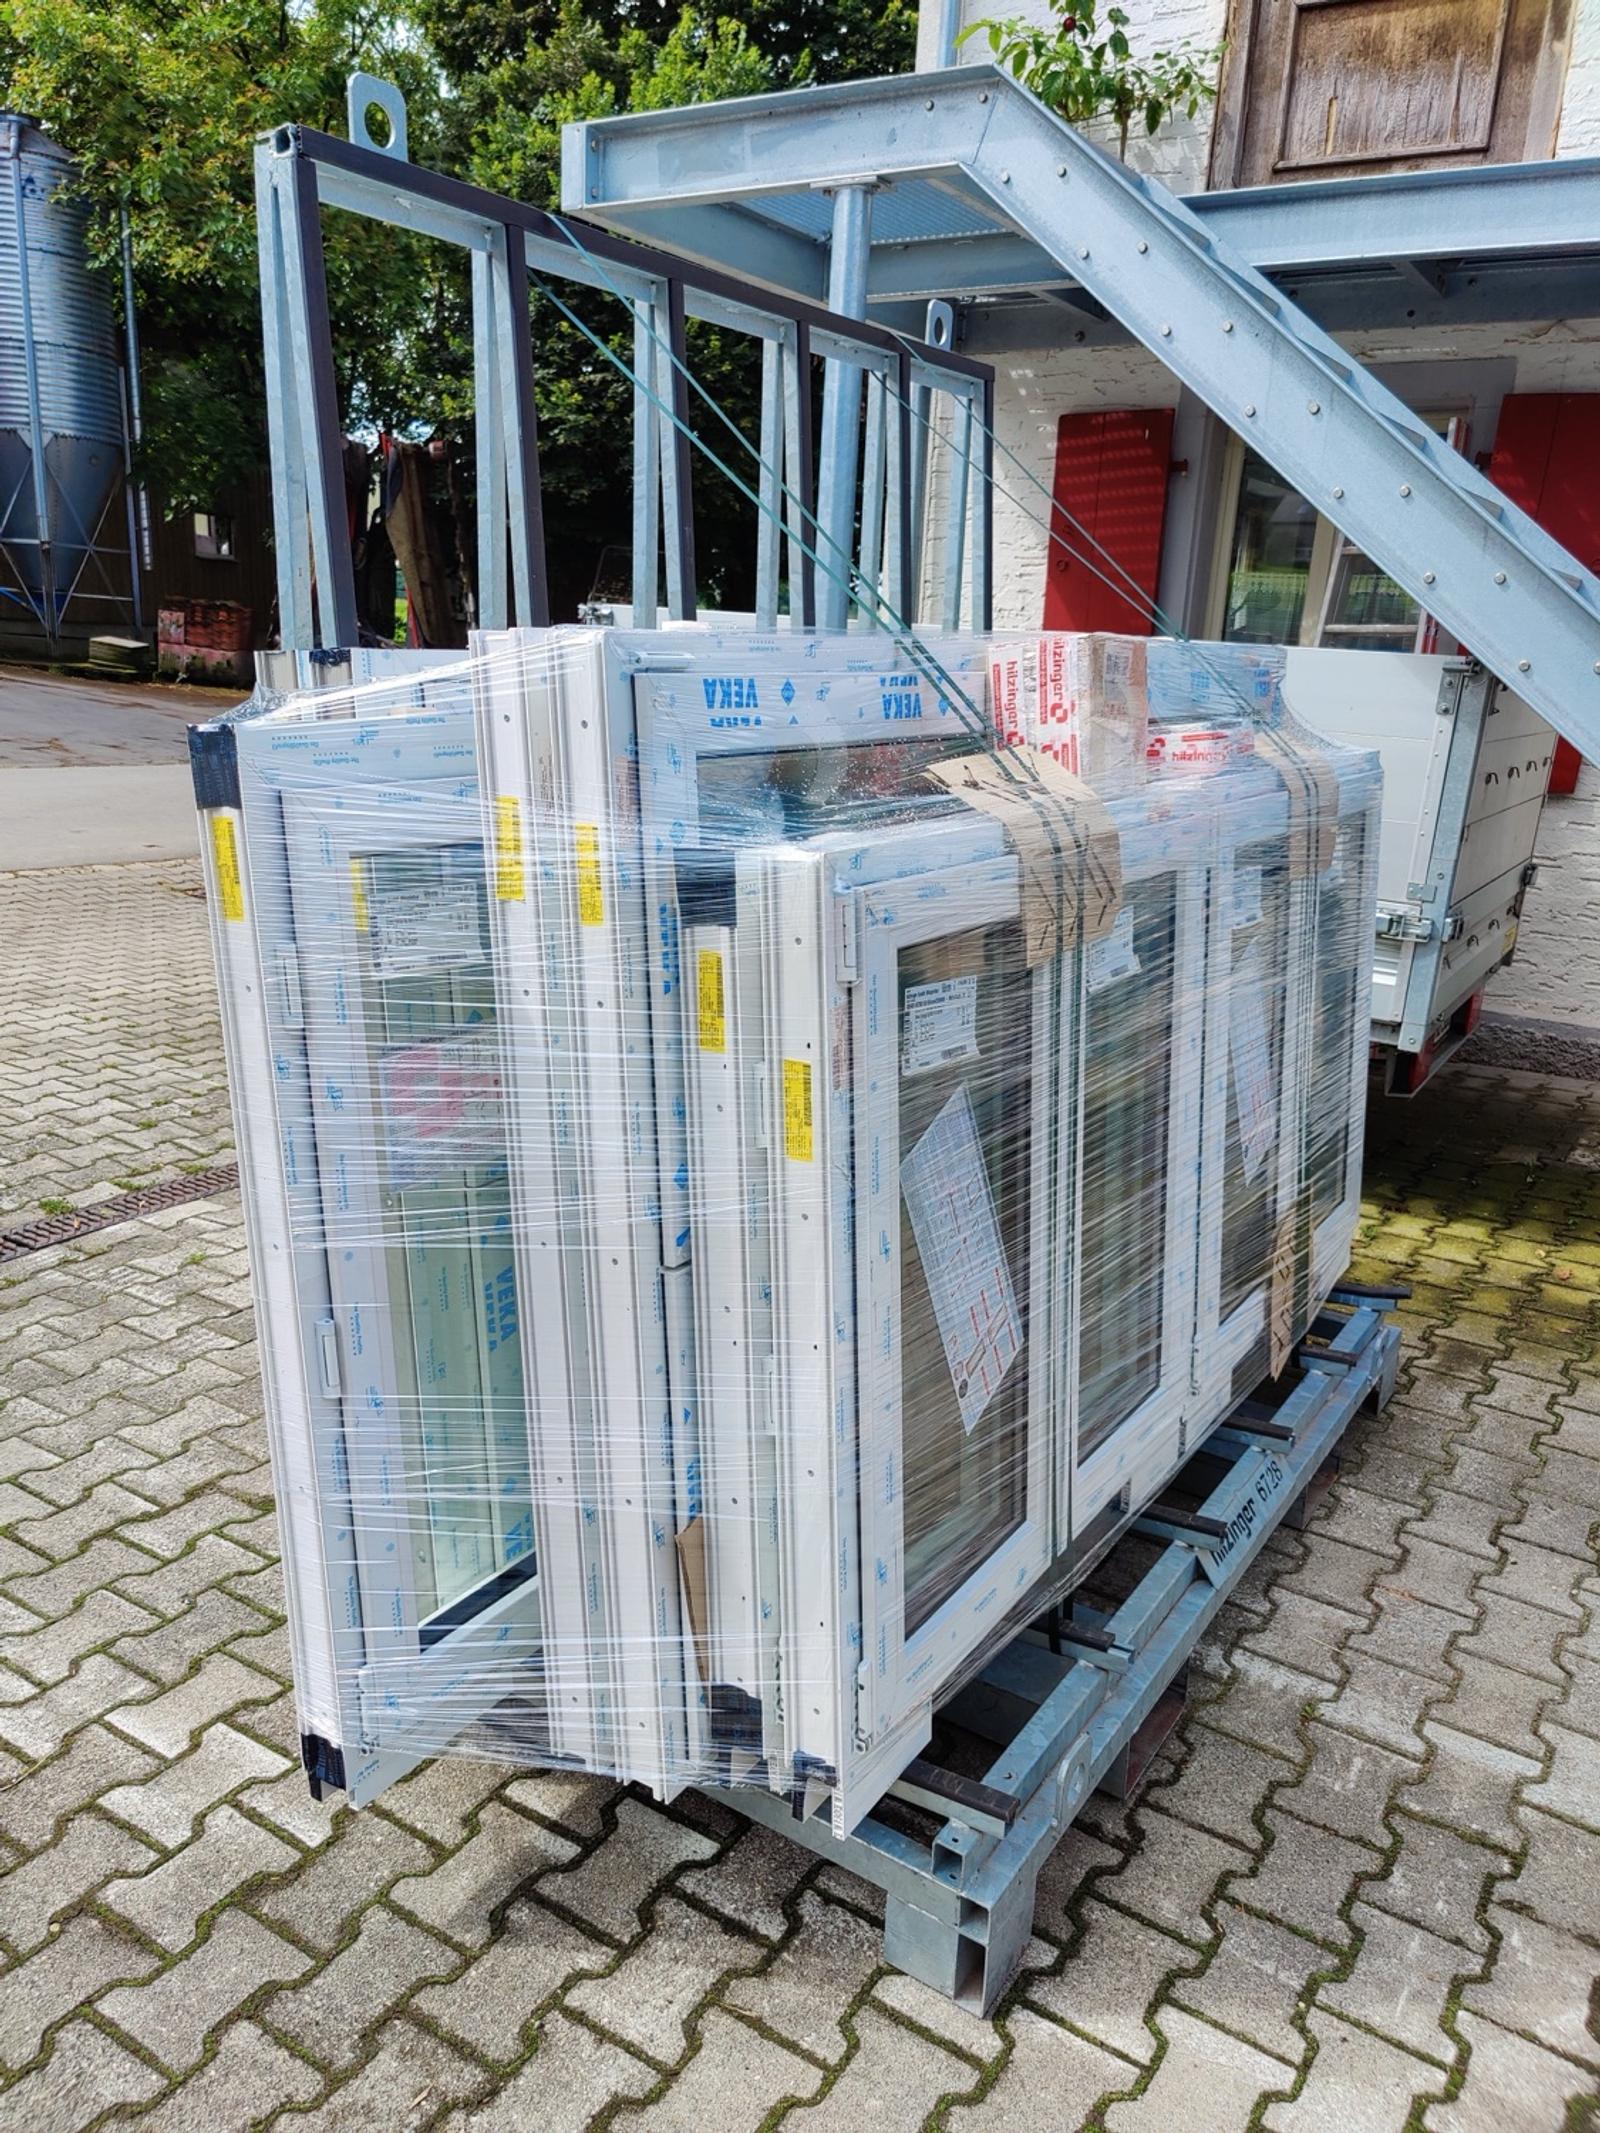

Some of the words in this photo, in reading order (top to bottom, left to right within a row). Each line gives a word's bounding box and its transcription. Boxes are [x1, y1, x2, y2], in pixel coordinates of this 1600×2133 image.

[702, 677, 760, 710] VEKA
[881, 693, 923, 721] VEKA
[1004, 660, 1019, 729] hilzinger
[495, 1265, 518, 1342] VEKA
[1255, 1460, 1284, 1502] 6728
